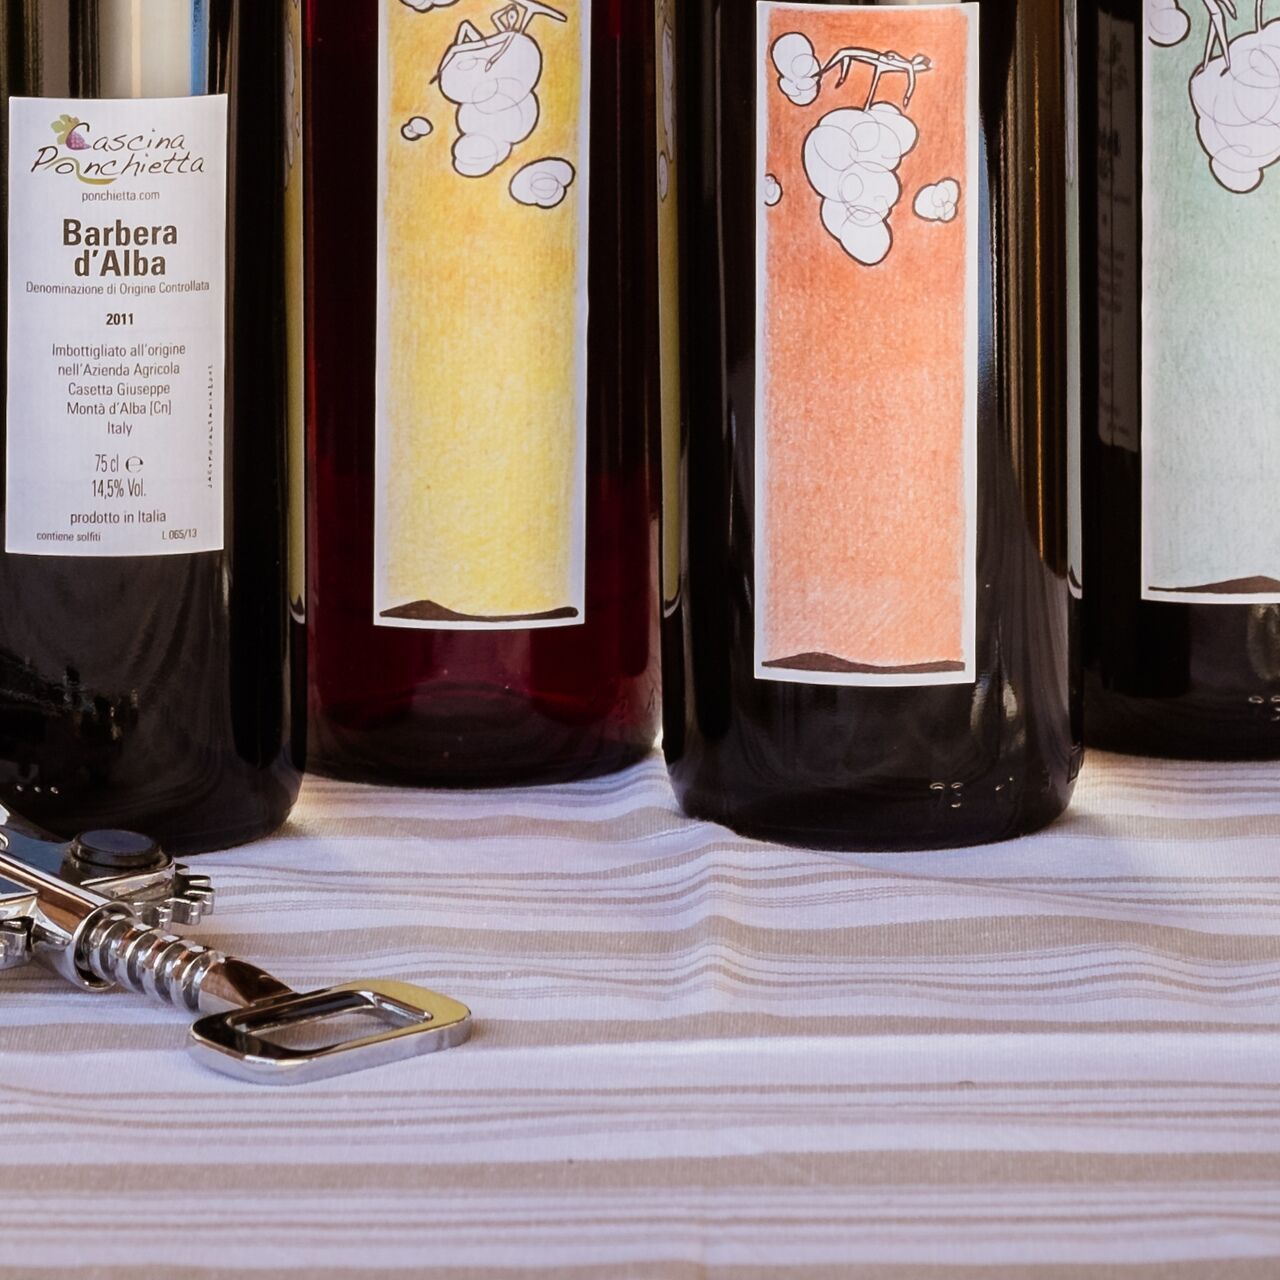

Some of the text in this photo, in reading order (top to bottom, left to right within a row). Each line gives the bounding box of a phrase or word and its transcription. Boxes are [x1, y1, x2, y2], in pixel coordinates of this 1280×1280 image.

[65, 122, 186, 152] Cascina
[30, 145, 205, 178] Ponchietta
[81, 189, 160, 203] ponchietta.com
[62, 218, 178, 246] Barbera
[73, 249, 166, 277] d'Alba
[25, 280, 210, 296] Denominazione di Origine Controllata
[105, 313, 134, 326] 2011
[51, 343, 186, 360] Imbottigliato all'origine
[57, 361, 180, 379] nell'Azienda Agricola
[68, 381, 171, 397] Casetta Giuseppe
[66, 401, 106, 415] Montà
[108, 400, 147, 415] d'Alba
[107, 421, 133, 436] Italy
[94, 454, 108, 472] 75
[109, 454, 119, 472] cl
[91, 478, 147, 499] 14,5% Vol.
[70, 509, 167, 526] prodotto in Italia
[36, 531, 101, 542] contiene solfiti
